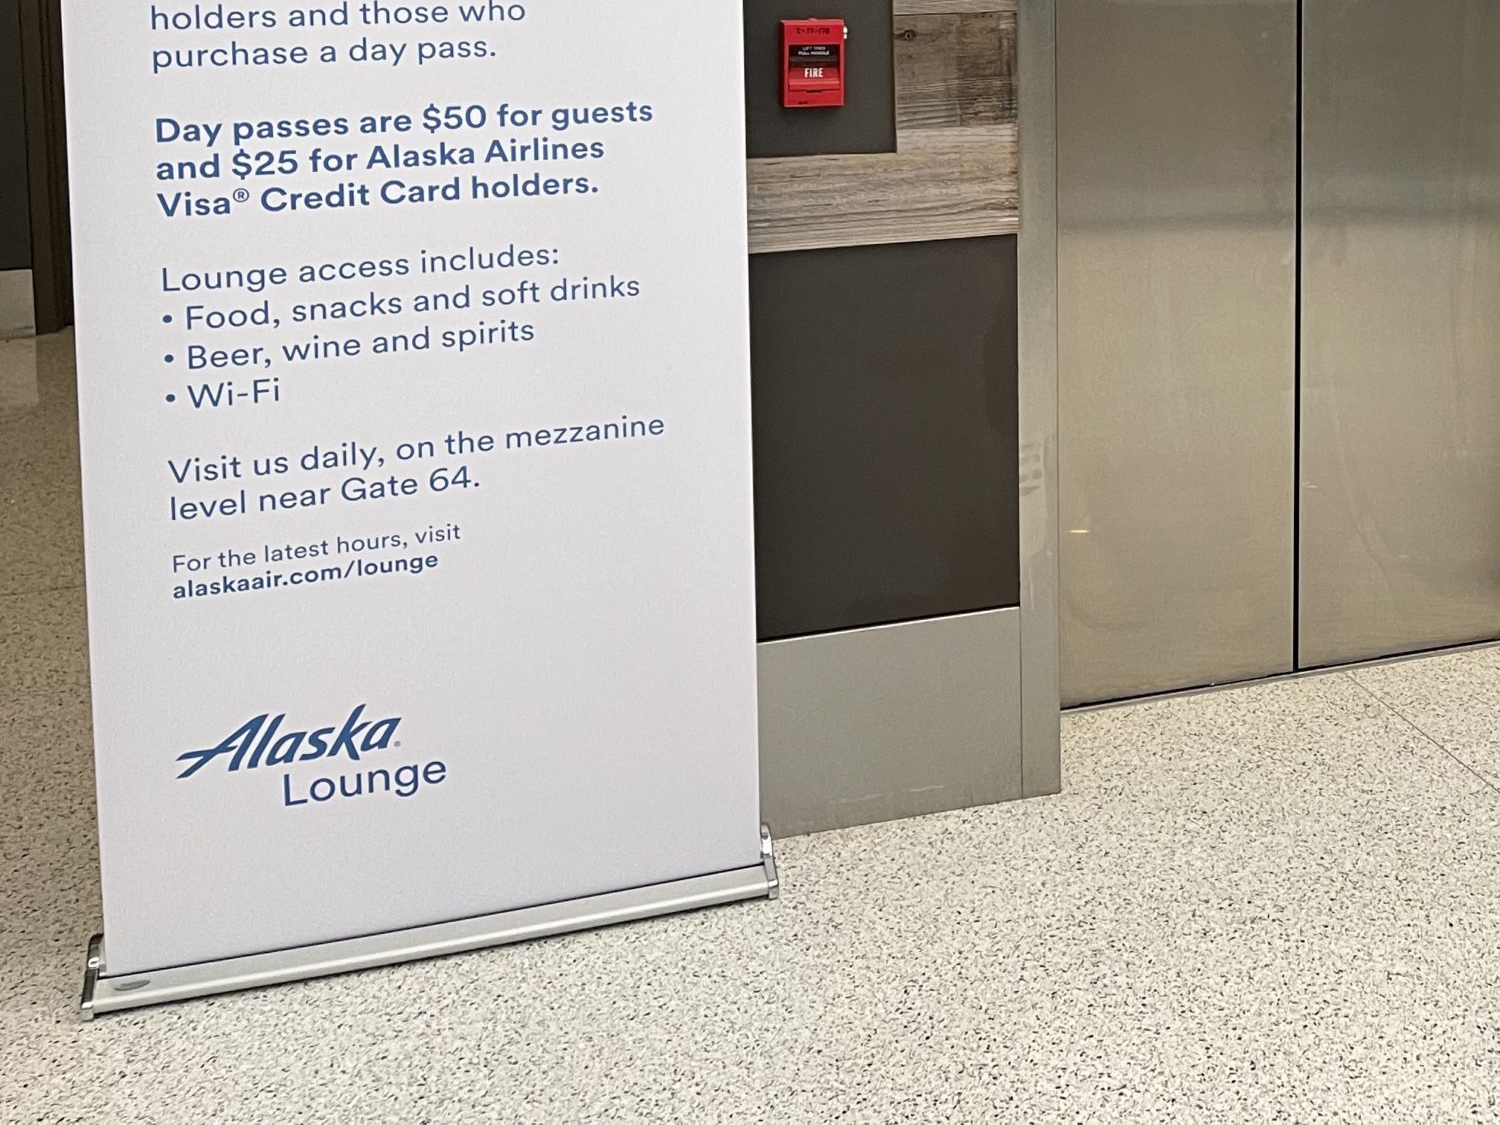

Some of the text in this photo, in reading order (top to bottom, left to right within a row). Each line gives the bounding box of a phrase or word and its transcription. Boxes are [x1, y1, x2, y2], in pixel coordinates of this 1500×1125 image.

[150, 3, 277, 31] holders
[288, 0, 349, 28] and
[358, 0, 449, 25] those
[152, 36, 496, 75] purchase a day pass.
[804, 67, 824, 78] FIRE
[155, 101, 653, 148] Day passes are $50 for guests
[156, 136, 605, 181] and $25 for Alaska Airlines
[260, 181, 371, 213] Credit
[380, 176, 461, 205] Card
[471, 171, 599, 200] holders.
[161, 243, 559, 293] Lounge access includes:
[186, 274, 640, 331] Food, snacks and soft drinks
[187, 318, 535, 370] Beer, wine and spirits
[186, 376, 280, 409] Wi-Fi
[167, 414, 665, 484] Visit us daily, on the mezzanine
[170, 465, 480, 521] level near Gate 64.
[172, 523, 461, 574] For the latest hours, visit
[172, 554, 439, 600] alaskaair.com/lounge
[174, 703, 402, 781] Alaska
[283, 760, 447, 807] Lounge
